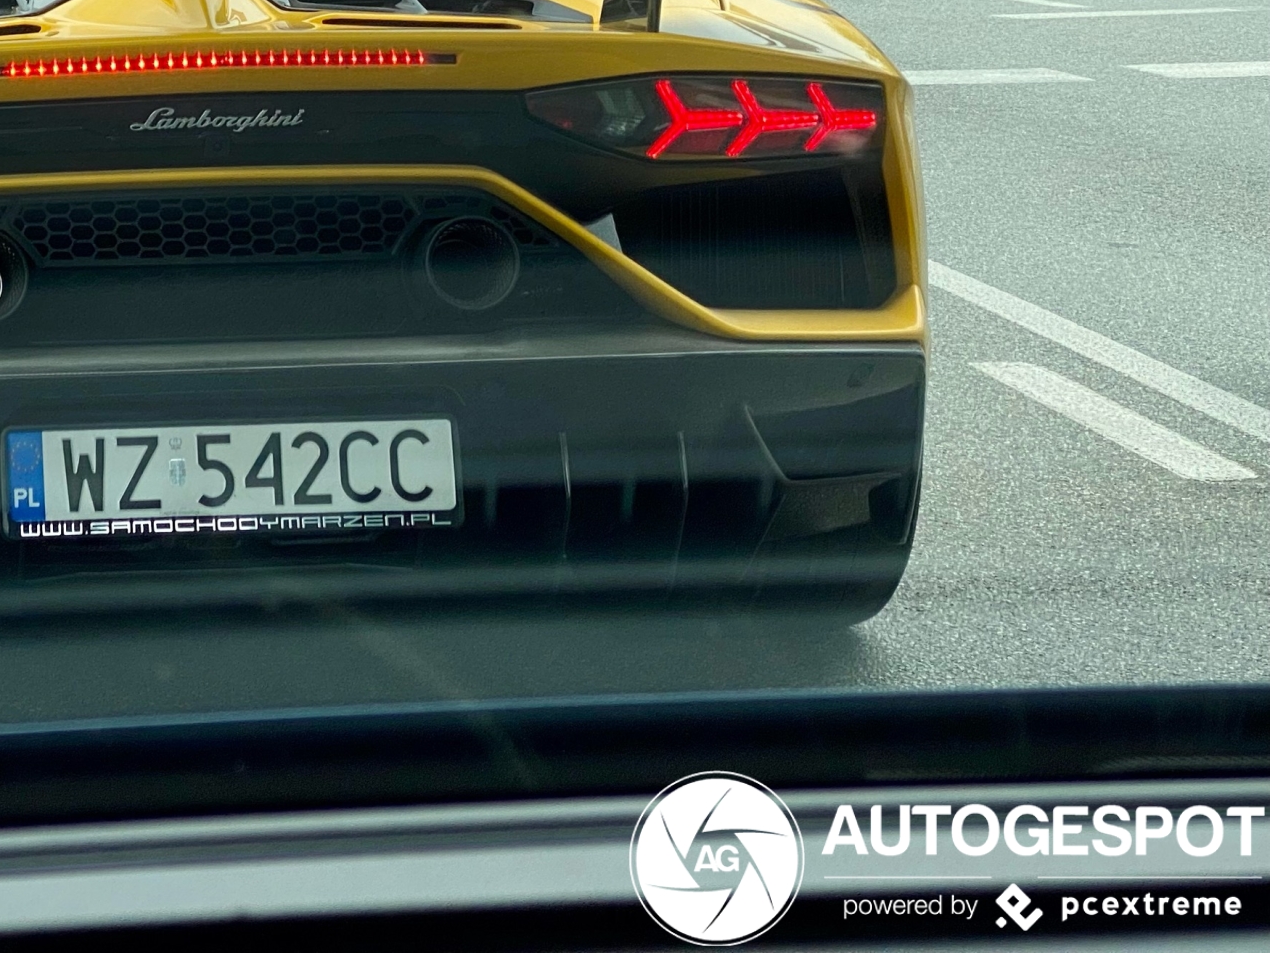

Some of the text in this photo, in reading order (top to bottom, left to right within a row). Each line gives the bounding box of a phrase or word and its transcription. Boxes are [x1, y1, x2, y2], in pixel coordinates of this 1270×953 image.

[129, 107, 305, 133] Lamborghini
[13, 429, 434, 513] PL WZ 542CC
